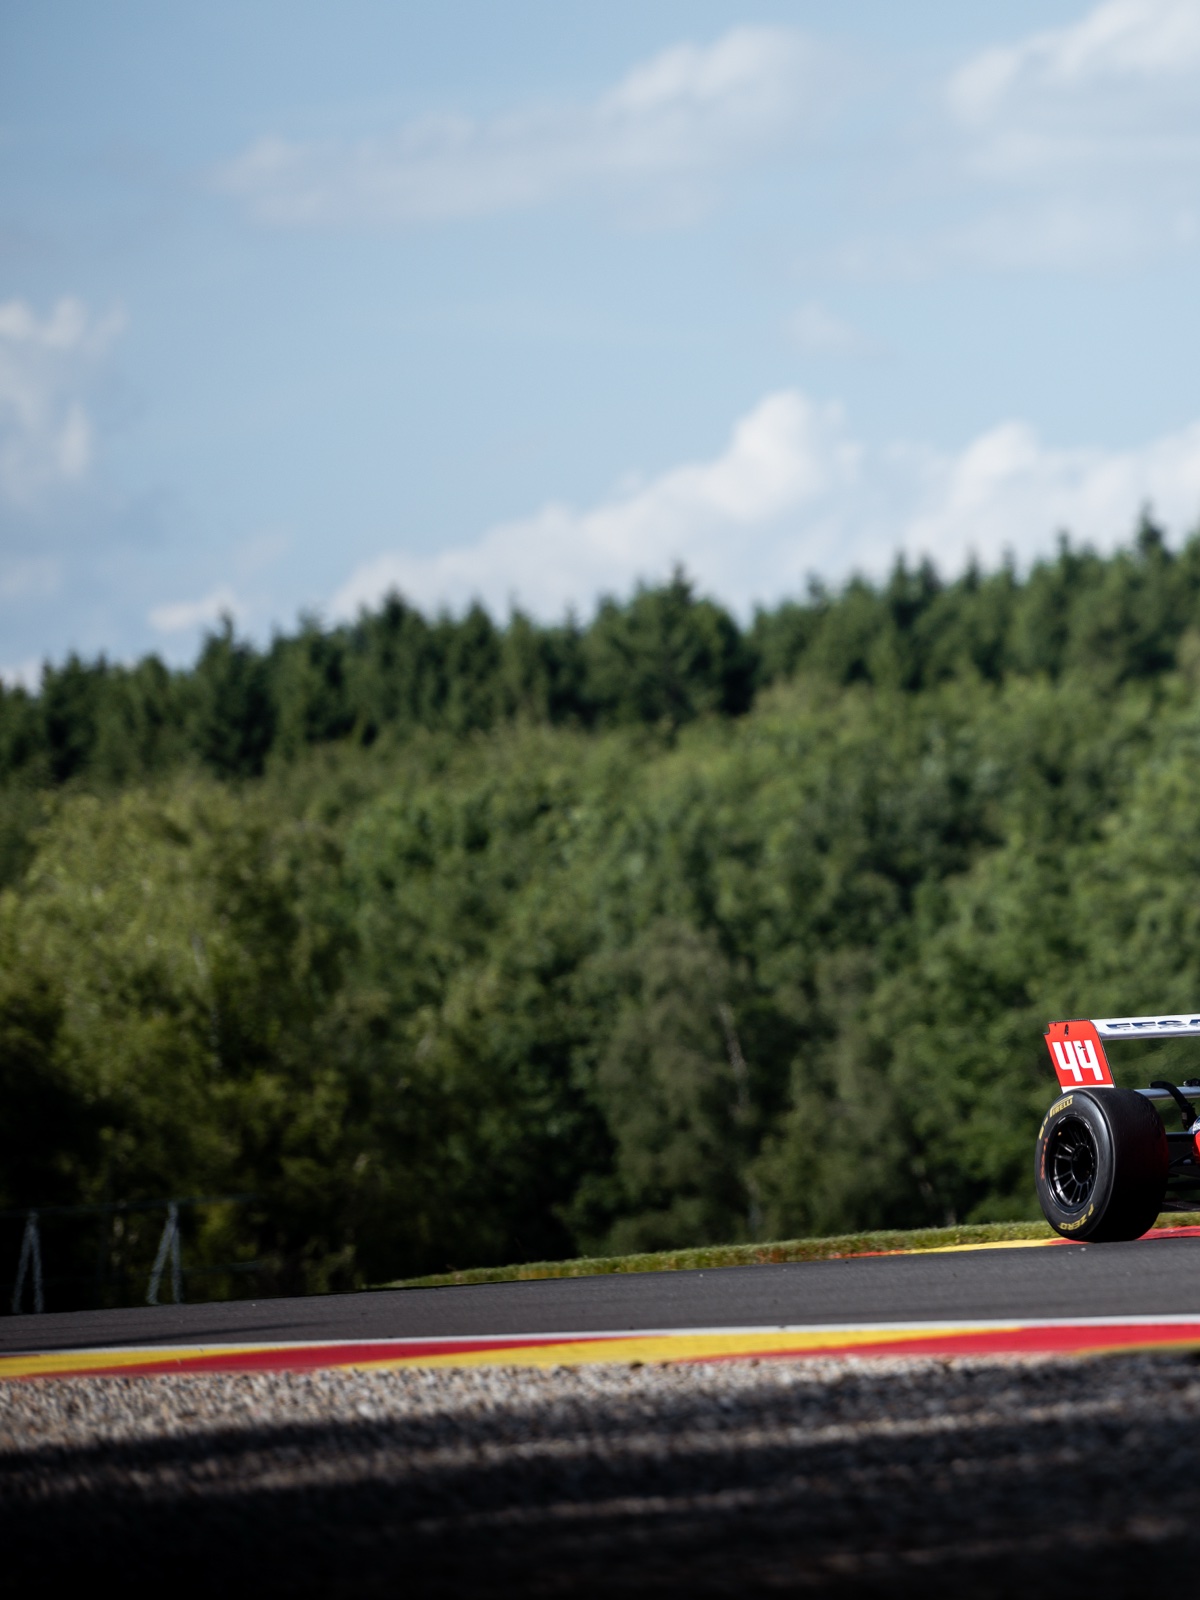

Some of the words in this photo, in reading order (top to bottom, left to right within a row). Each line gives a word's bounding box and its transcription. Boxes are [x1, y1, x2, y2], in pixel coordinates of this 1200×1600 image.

[1052, 1039, 1104, 1082] 44
[1049, 1094, 1074, 1118] PIRELLI
[1059, 1213, 1088, 1231] ZERO
